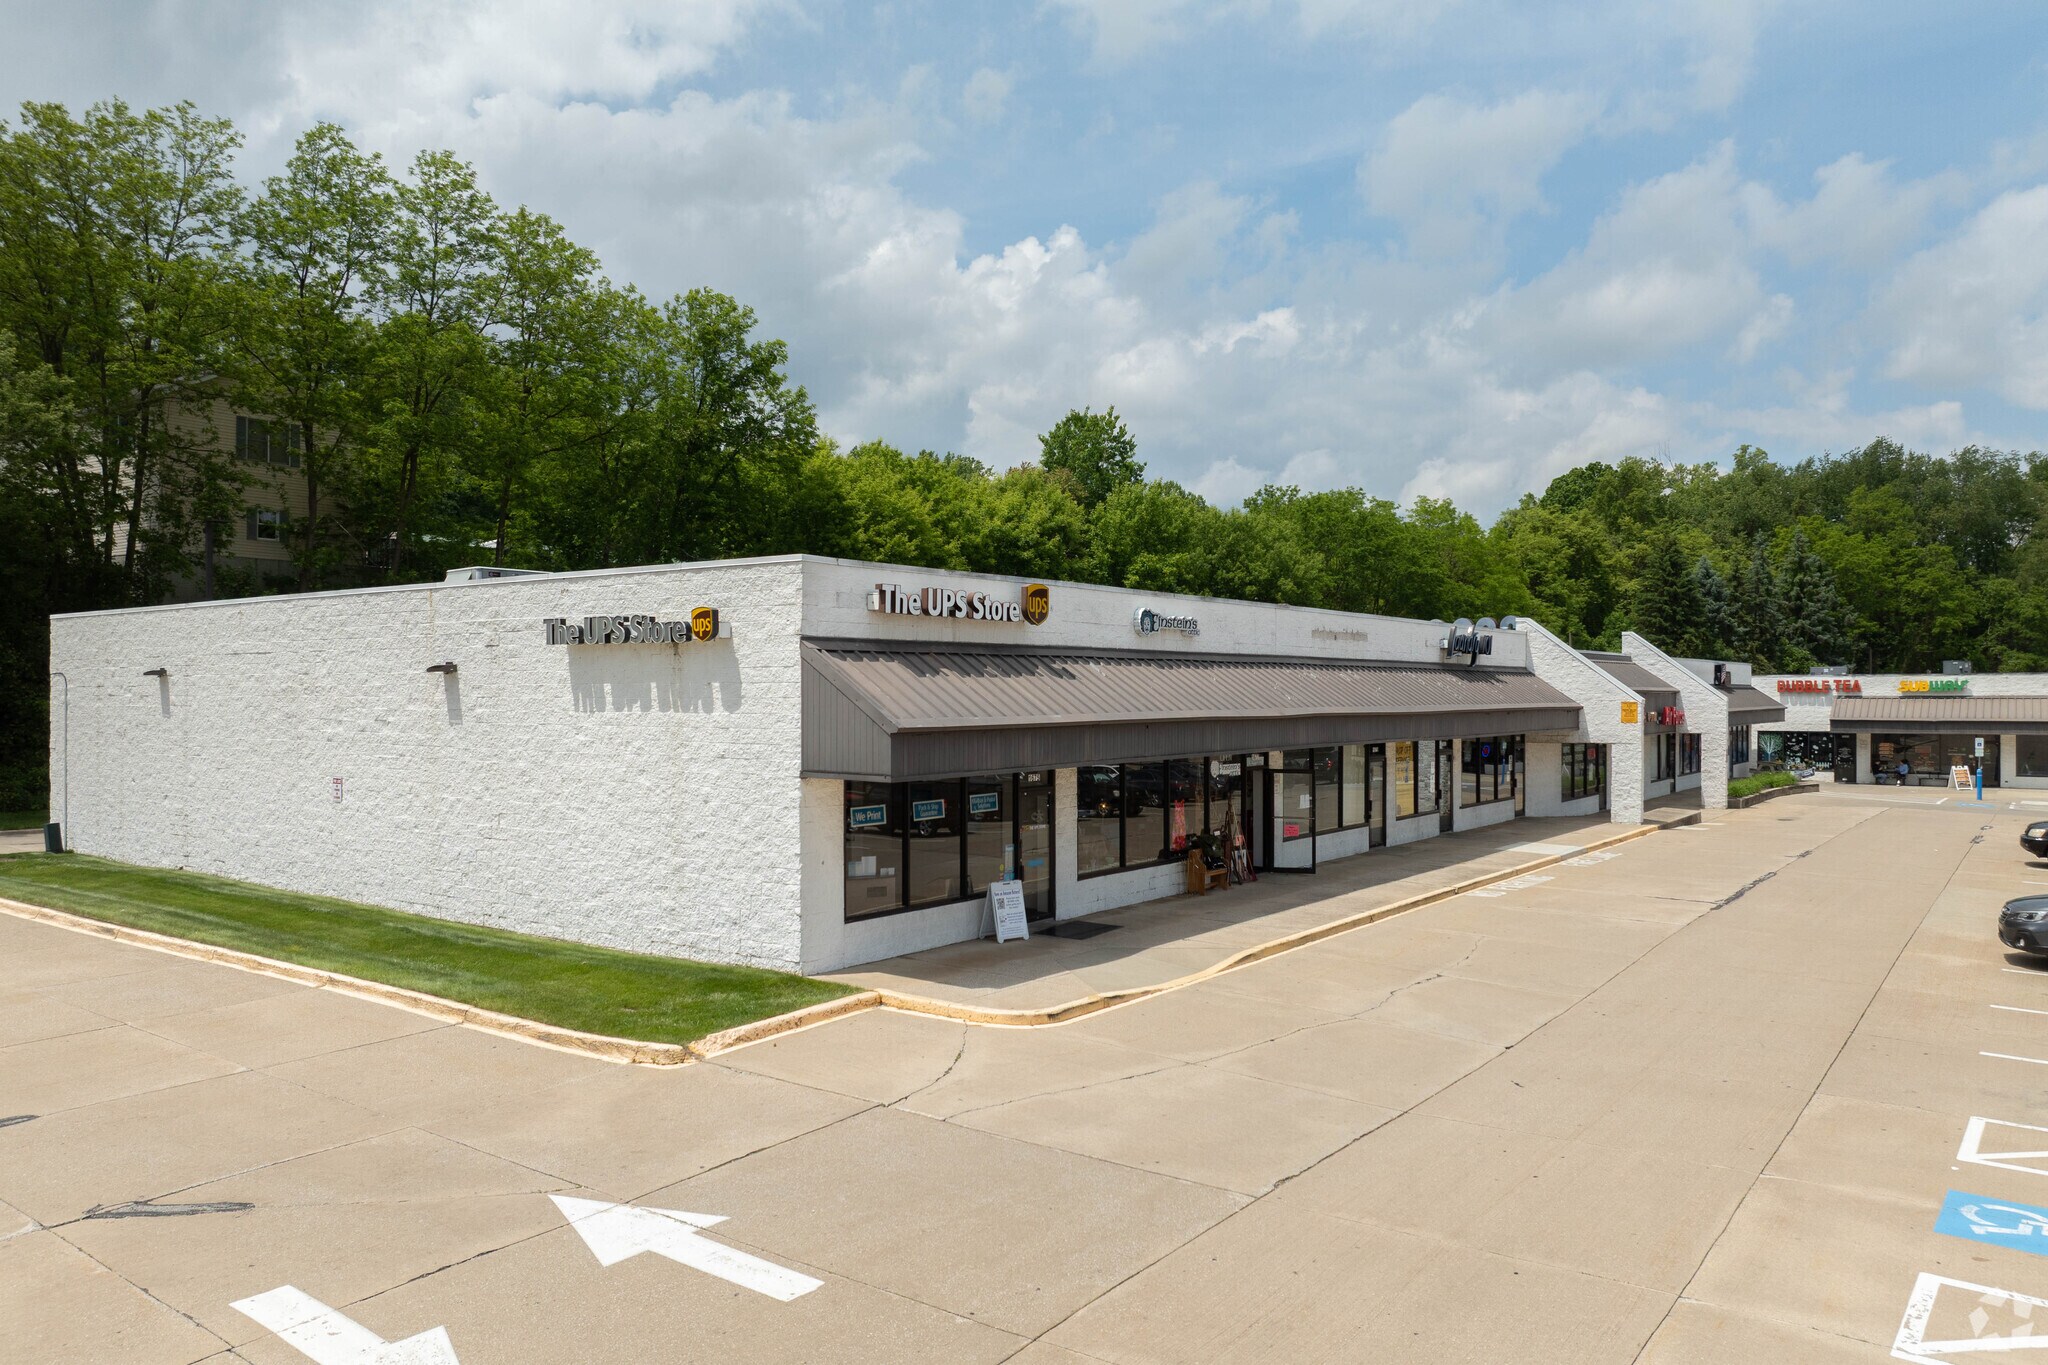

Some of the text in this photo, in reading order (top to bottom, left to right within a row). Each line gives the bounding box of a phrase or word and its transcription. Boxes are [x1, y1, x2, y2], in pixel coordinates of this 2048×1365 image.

[882, 583, 1021, 622] The UPS Store
[1028, 596, 1048, 621] ups
[543, 614, 688, 646] The UPS Store
[693, 617, 711, 639] ups
[1152, 613, 1198, 632] Einstein's
[1777, 679, 1862, 693] BUBBLE TEA
[1898, 680, 1970, 693] SUBWAY
[855, 810, 882, 822] We Print
